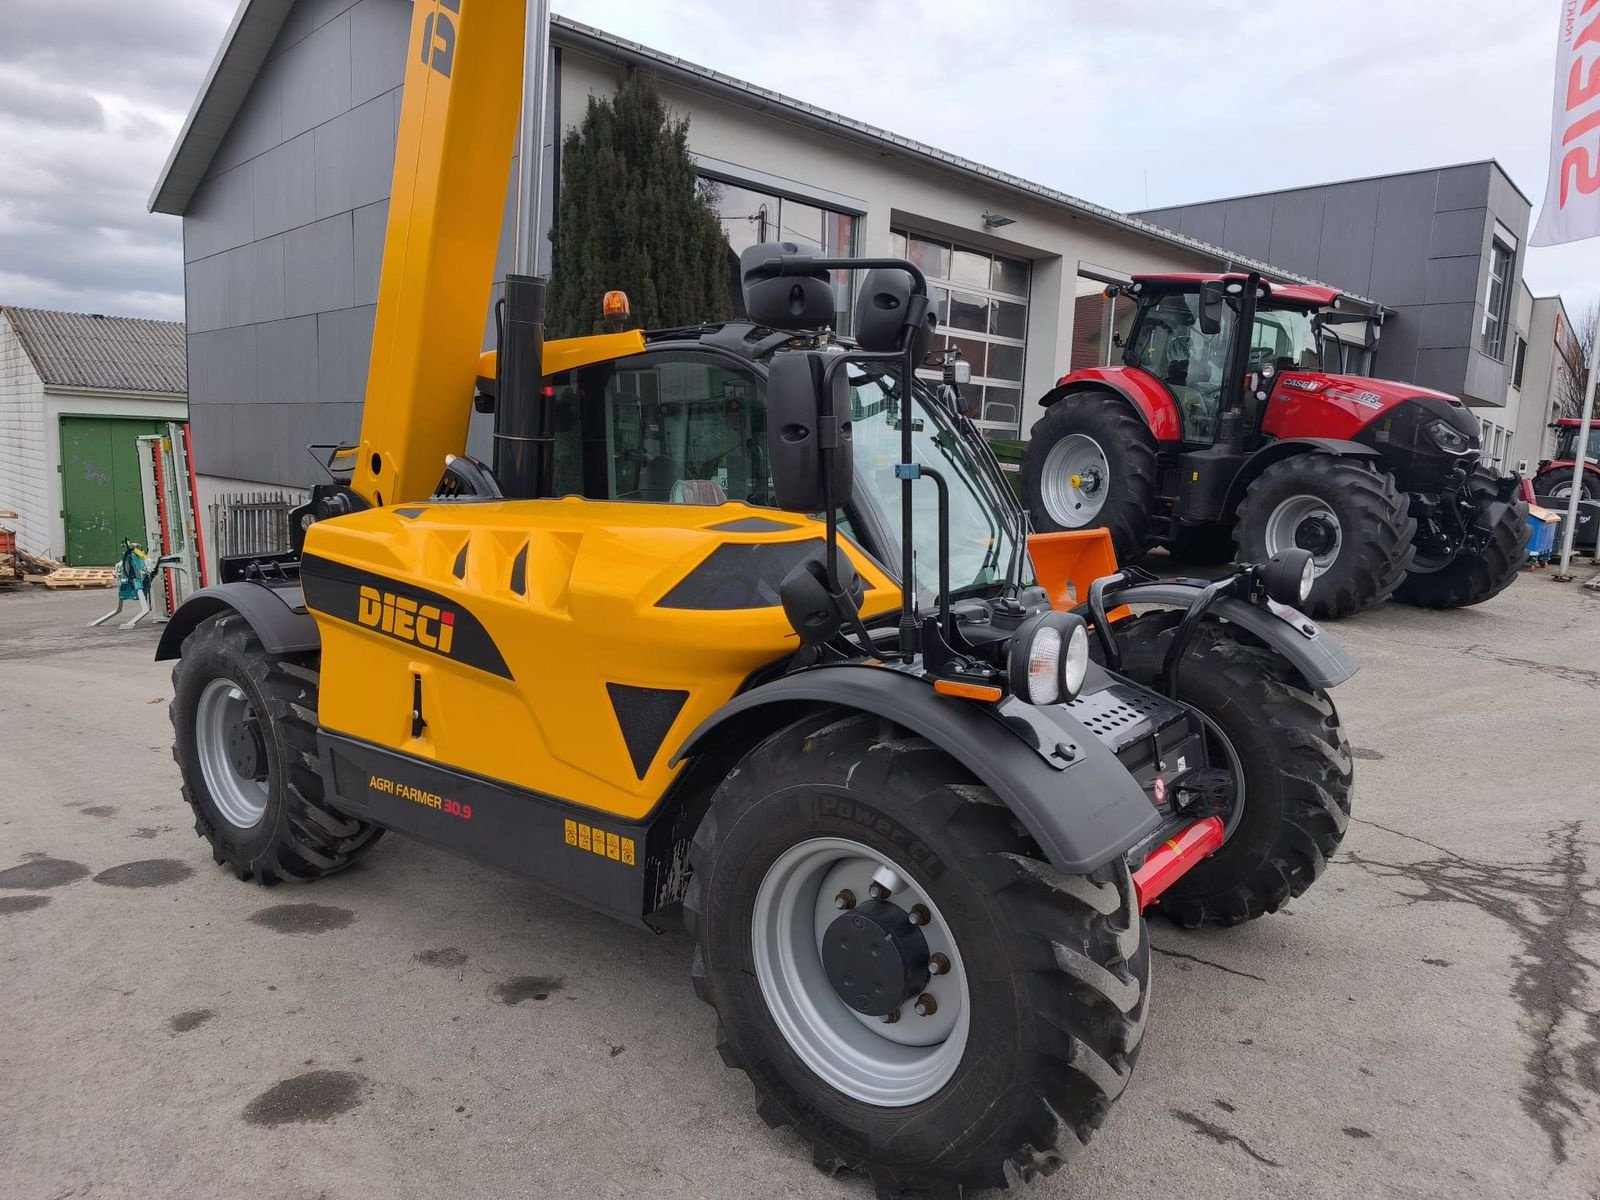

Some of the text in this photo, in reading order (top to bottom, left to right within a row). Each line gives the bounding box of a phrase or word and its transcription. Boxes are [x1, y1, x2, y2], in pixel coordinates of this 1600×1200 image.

[1283, 379, 1309, 390] CASE
[1360, 391, 1380, 404] 175
[369, 775, 472, 820] AGRI FARMER 30.9
